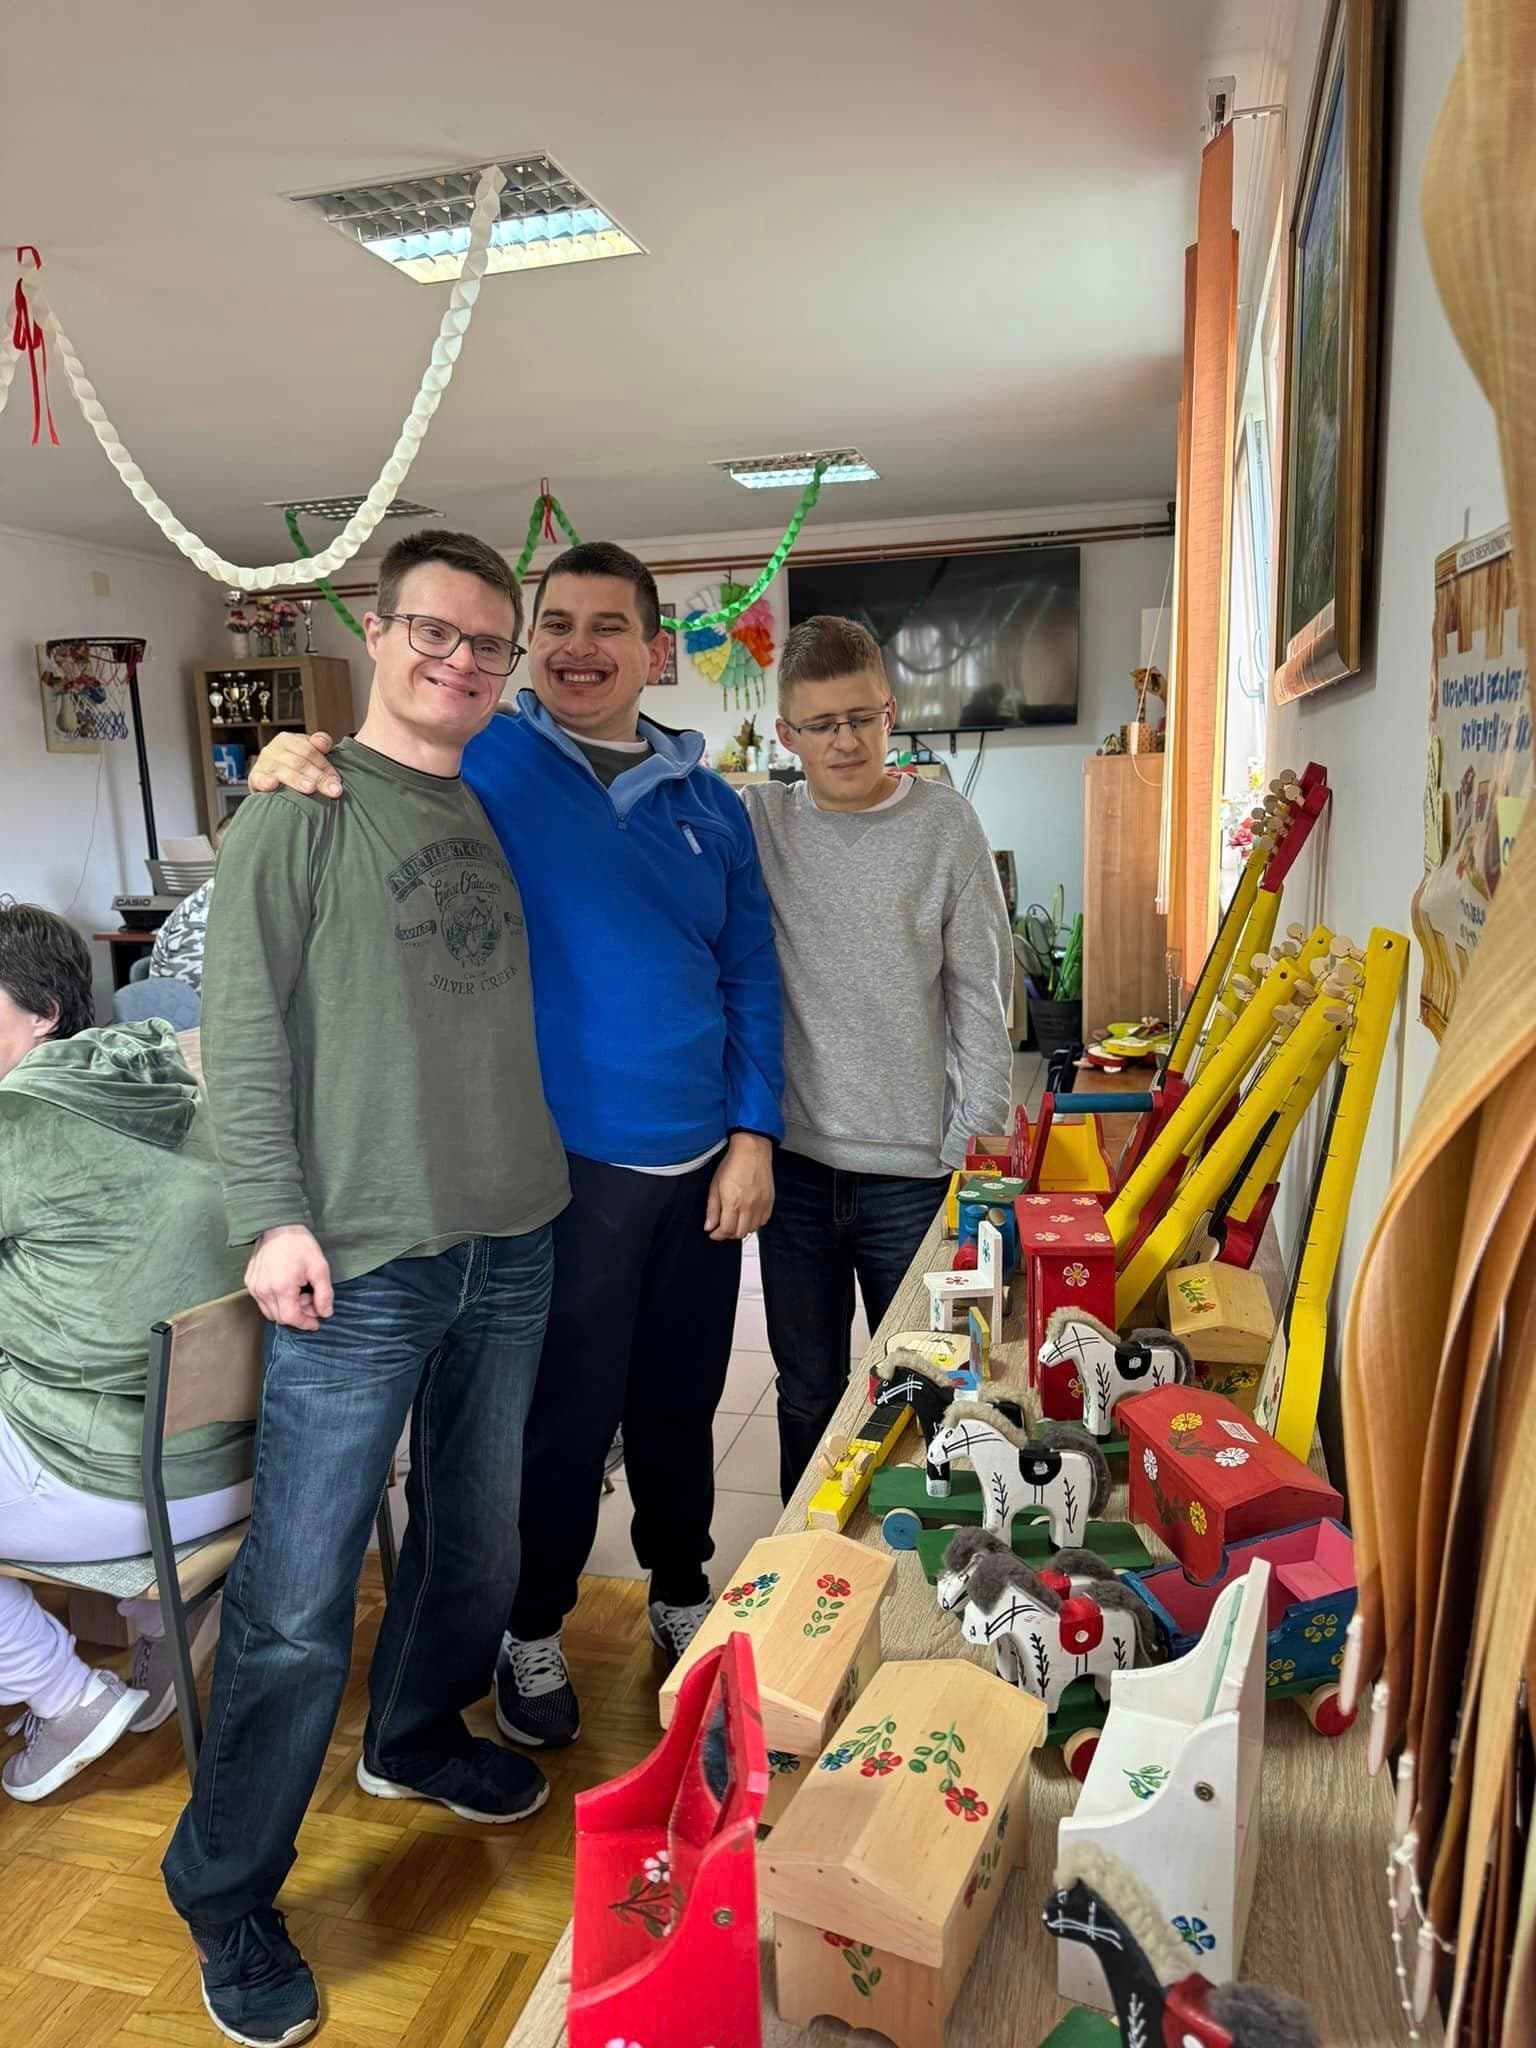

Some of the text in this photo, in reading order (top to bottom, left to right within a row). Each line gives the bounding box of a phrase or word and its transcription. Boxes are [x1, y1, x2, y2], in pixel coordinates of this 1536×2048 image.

[391, 842, 465, 889] NORTHERN
[116, 898, 151, 907] CASIO
[429, 879, 459, 906] Great
[430, 974, 475, 994] SILVER
